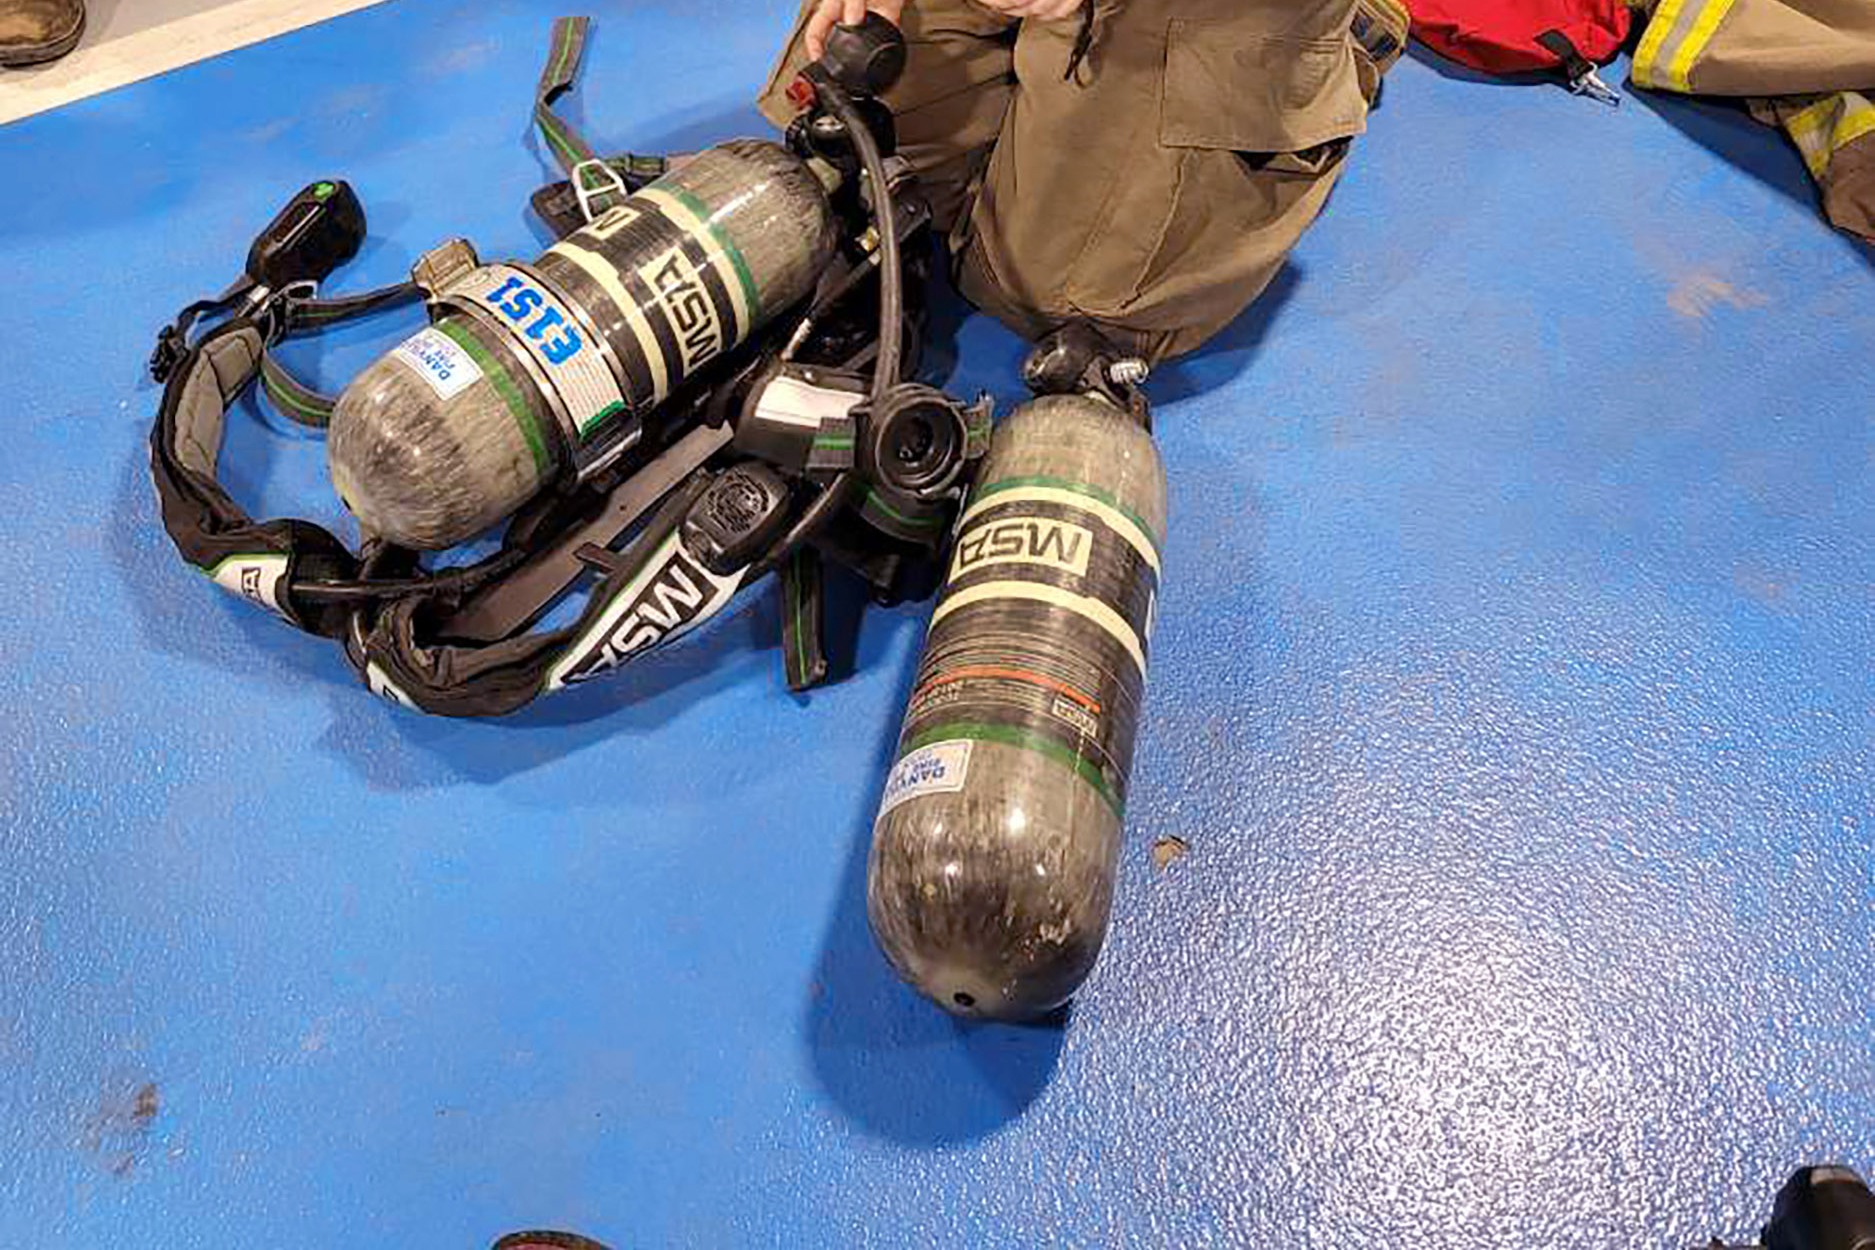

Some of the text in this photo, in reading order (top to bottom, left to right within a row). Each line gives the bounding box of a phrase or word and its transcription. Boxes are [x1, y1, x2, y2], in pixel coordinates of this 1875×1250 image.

[486, 276, 583, 365] E1S1
[655, 254, 717, 368] MSA
[959, 522, 1082, 568] MSA
